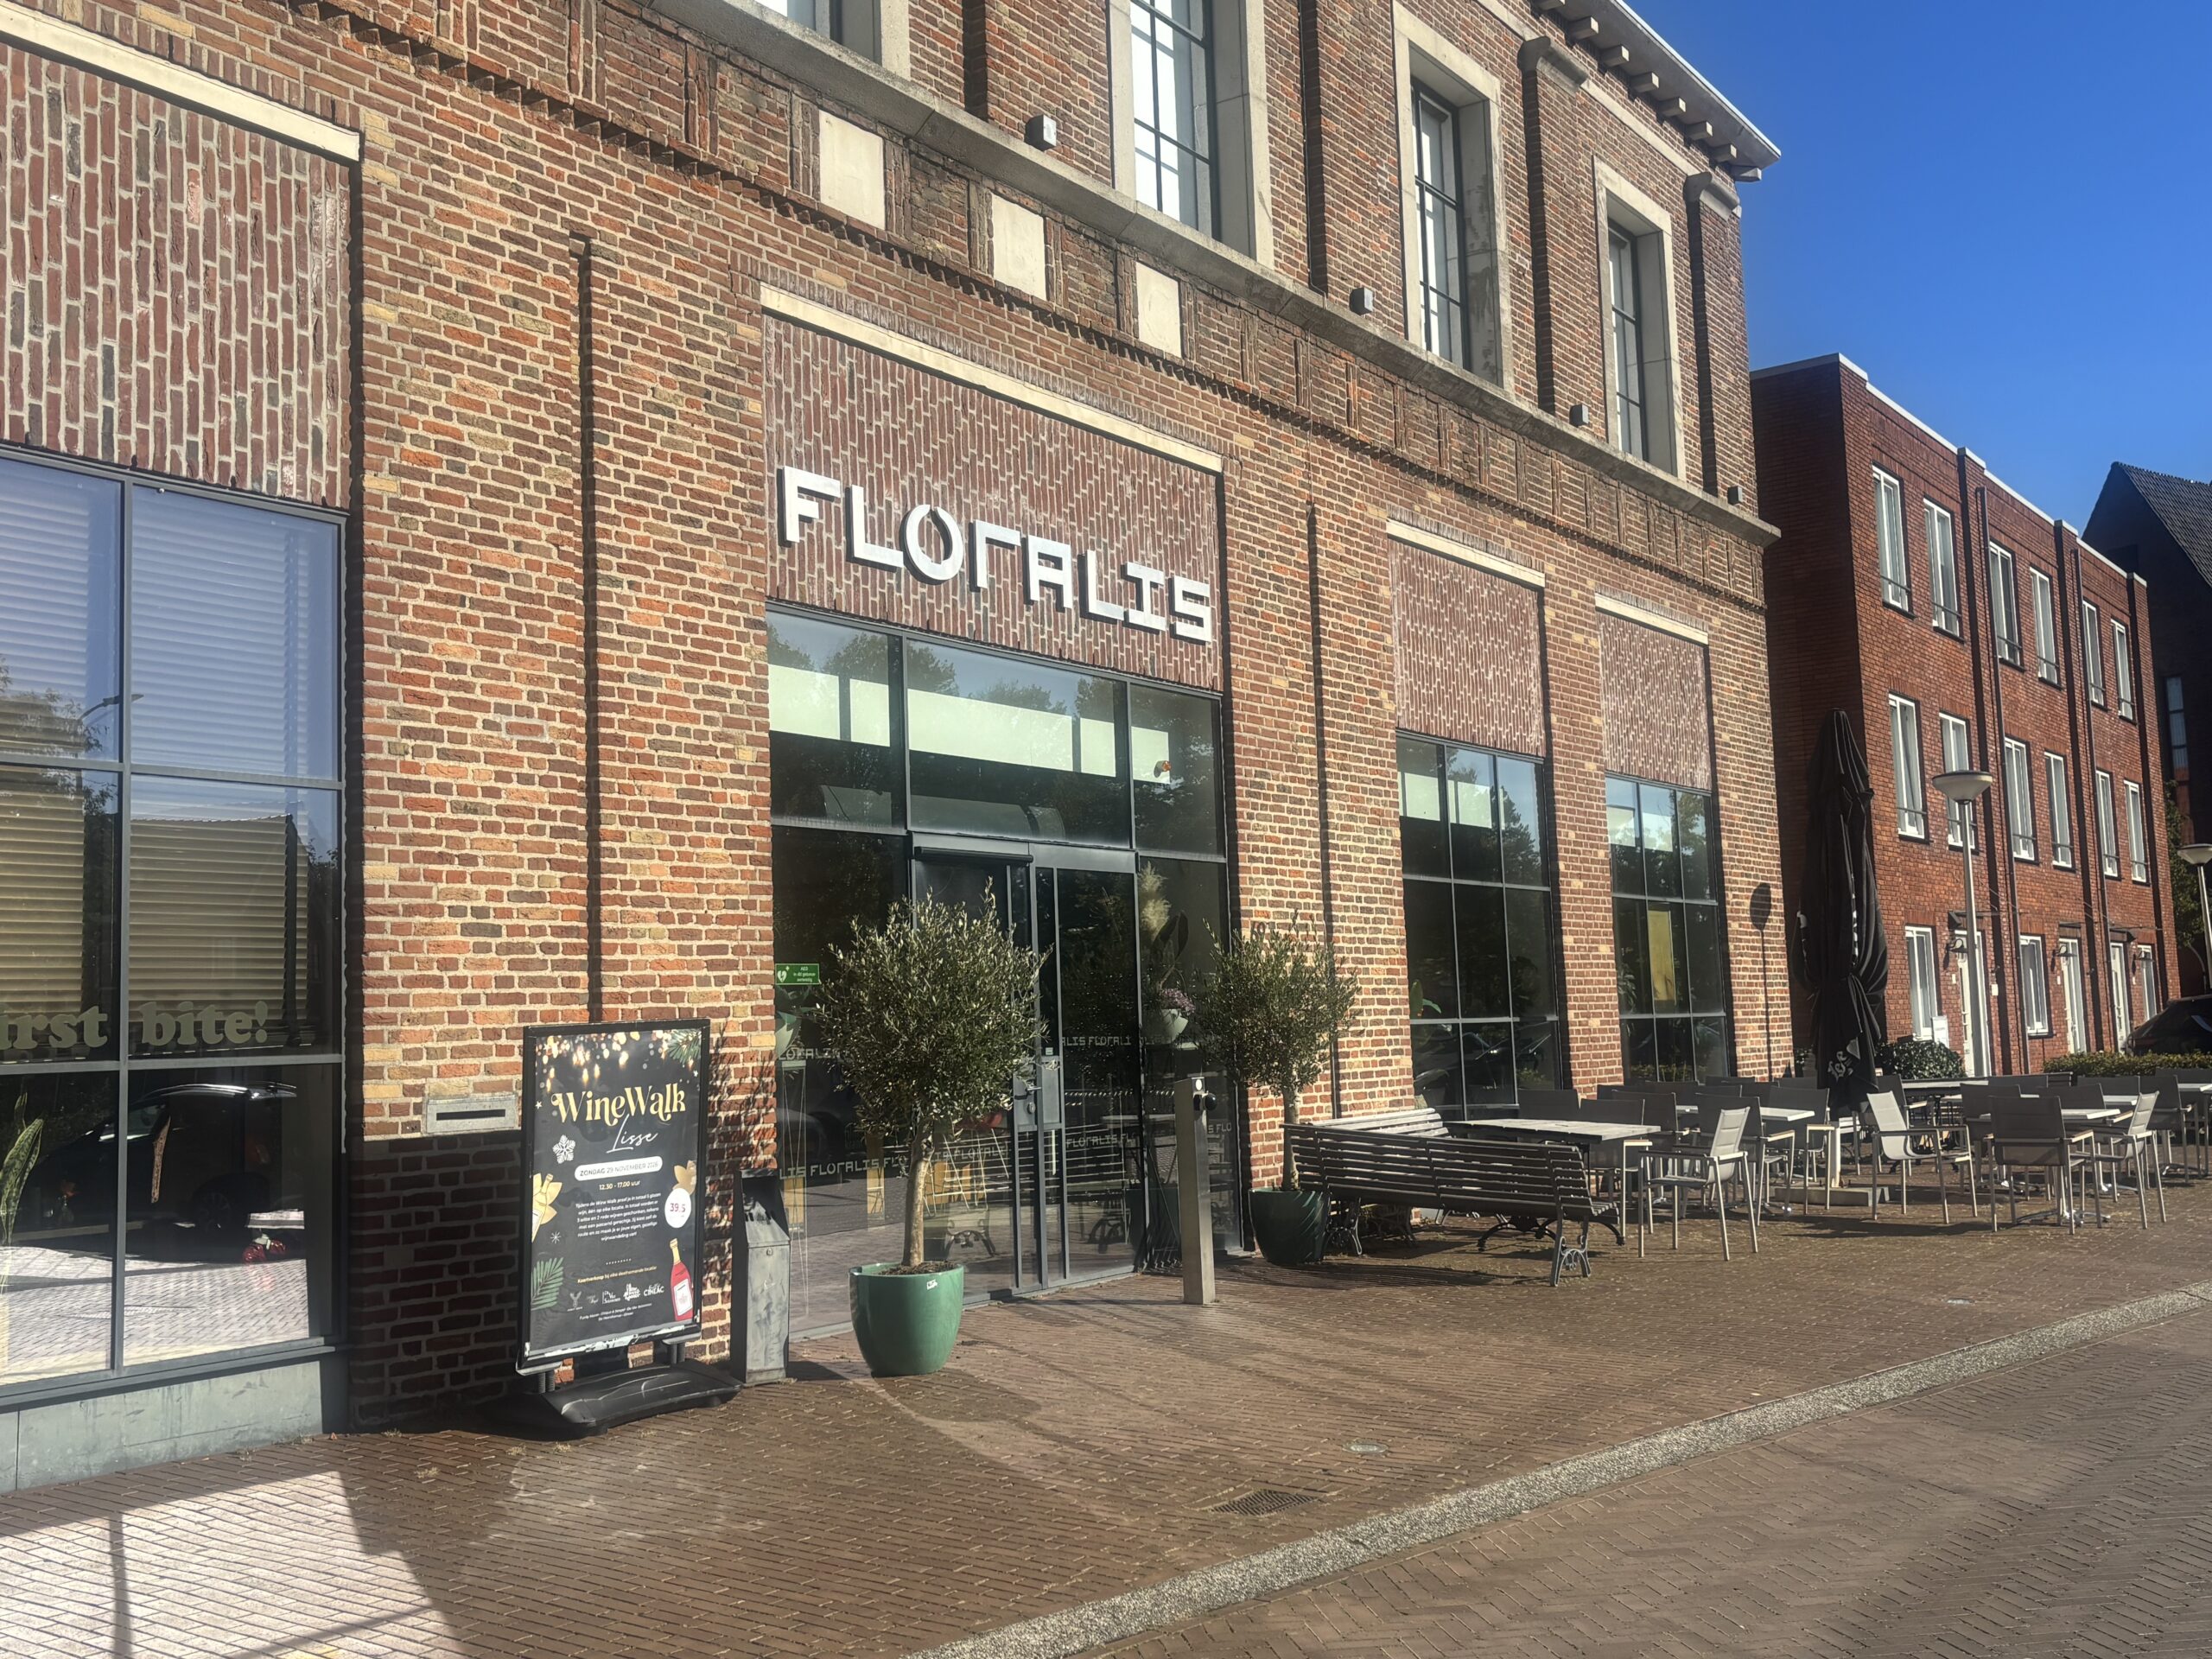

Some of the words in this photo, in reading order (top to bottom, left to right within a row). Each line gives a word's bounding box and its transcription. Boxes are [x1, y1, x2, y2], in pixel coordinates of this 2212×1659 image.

[137, 1001, 268, 1046] bite!
[606, 1113, 658, 1154] Lisse
[615, 1163, 645, 1172] NOVEMBER
